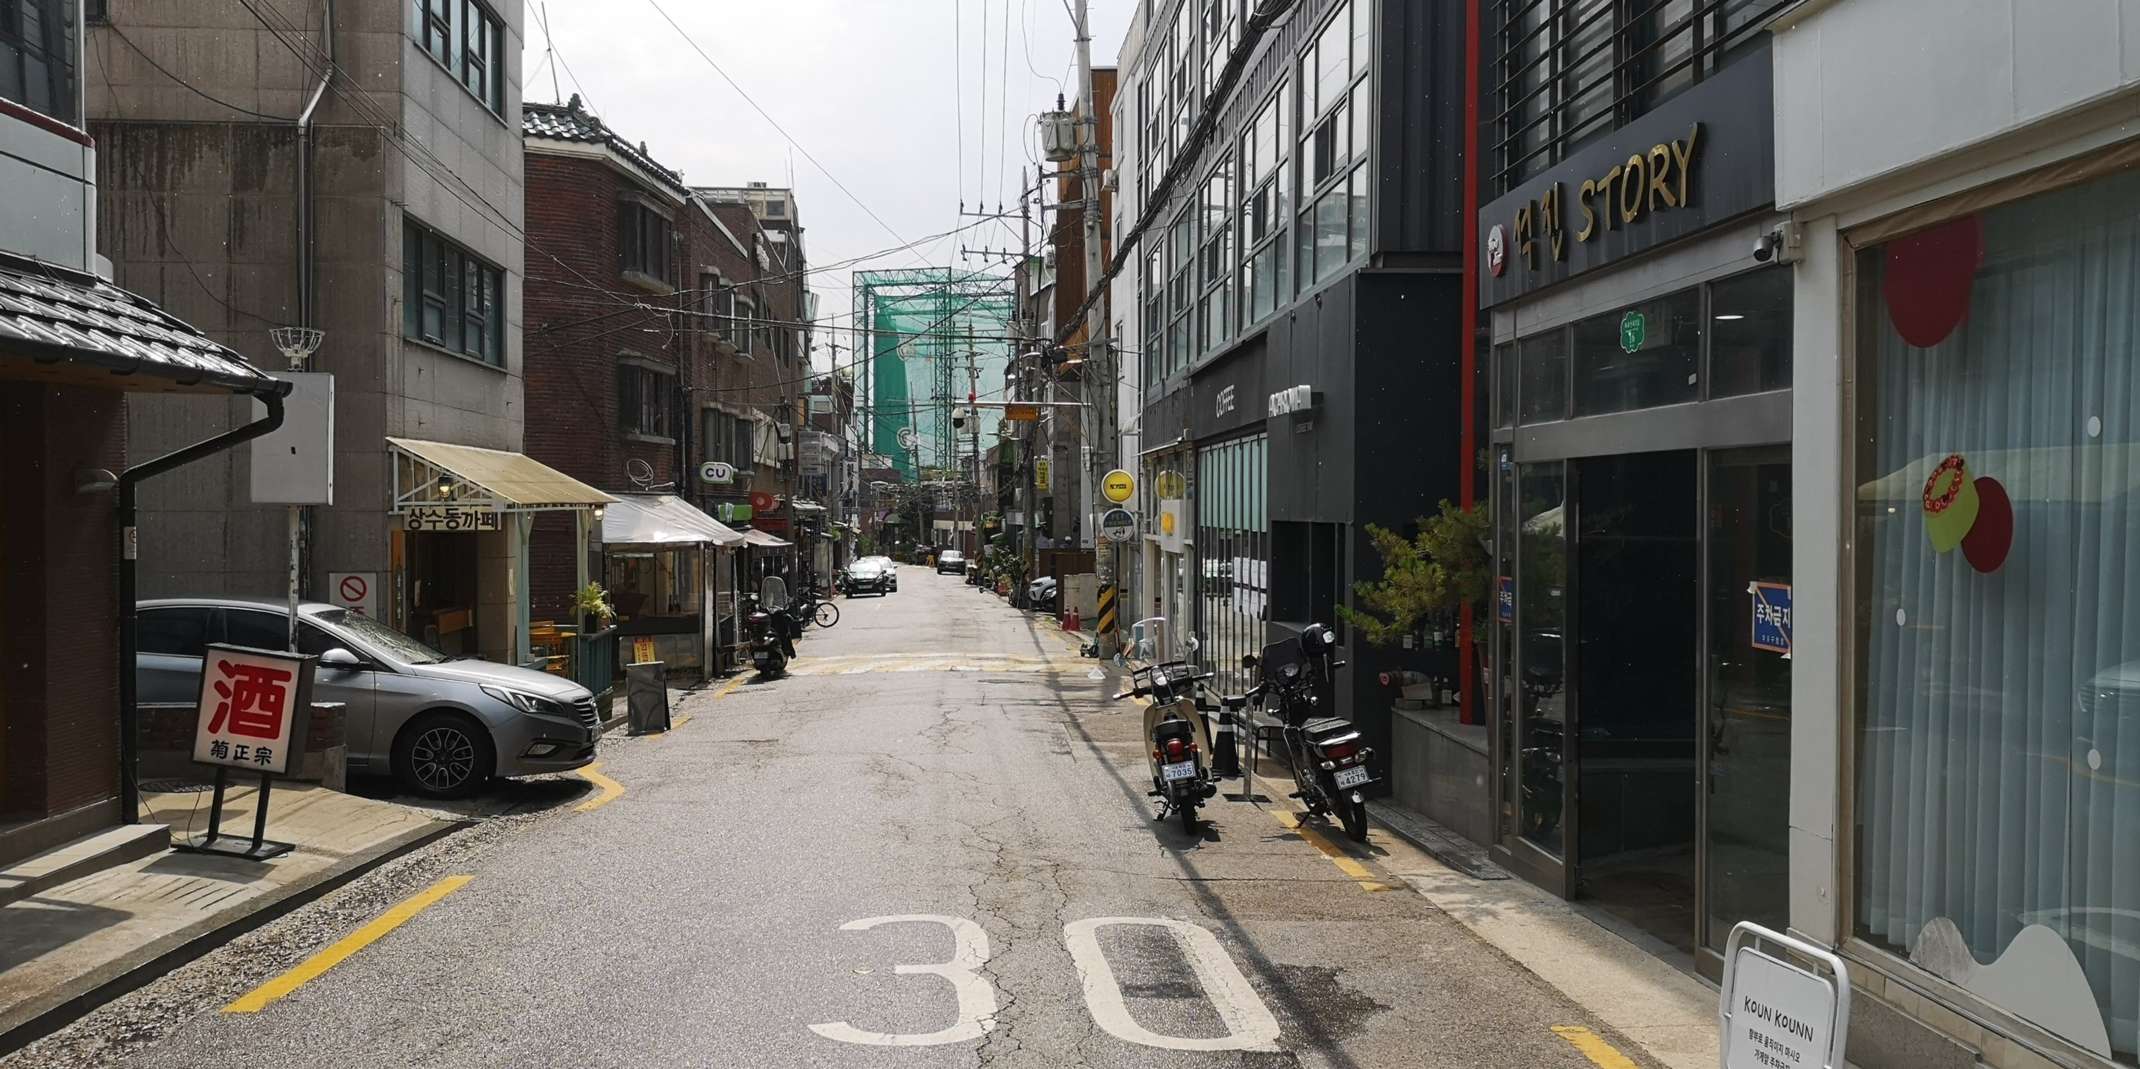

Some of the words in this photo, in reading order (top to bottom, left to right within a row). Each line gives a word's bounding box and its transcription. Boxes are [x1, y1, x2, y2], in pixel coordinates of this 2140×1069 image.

[1576, 121, 1699, 243] STORY
[1216, 384, 1235, 418] COFFEE
[705, 468, 726, 478] CU
[408, 507, 499, 530] 상수동까페
[1756, 603, 1790, 629] 주차금지
[208, 659, 292, 740] 酒
[210, 739, 273, 766] 菊正宗
[1171, 767, 1192, 777] 7035
[808, 914, 1282, 1052] 30
[1744, 995, 1772, 1022] KOUN
[1774, 1009, 1814, 1043] KOUNN
[1785, 1047, 1801, 1063] 마시오
